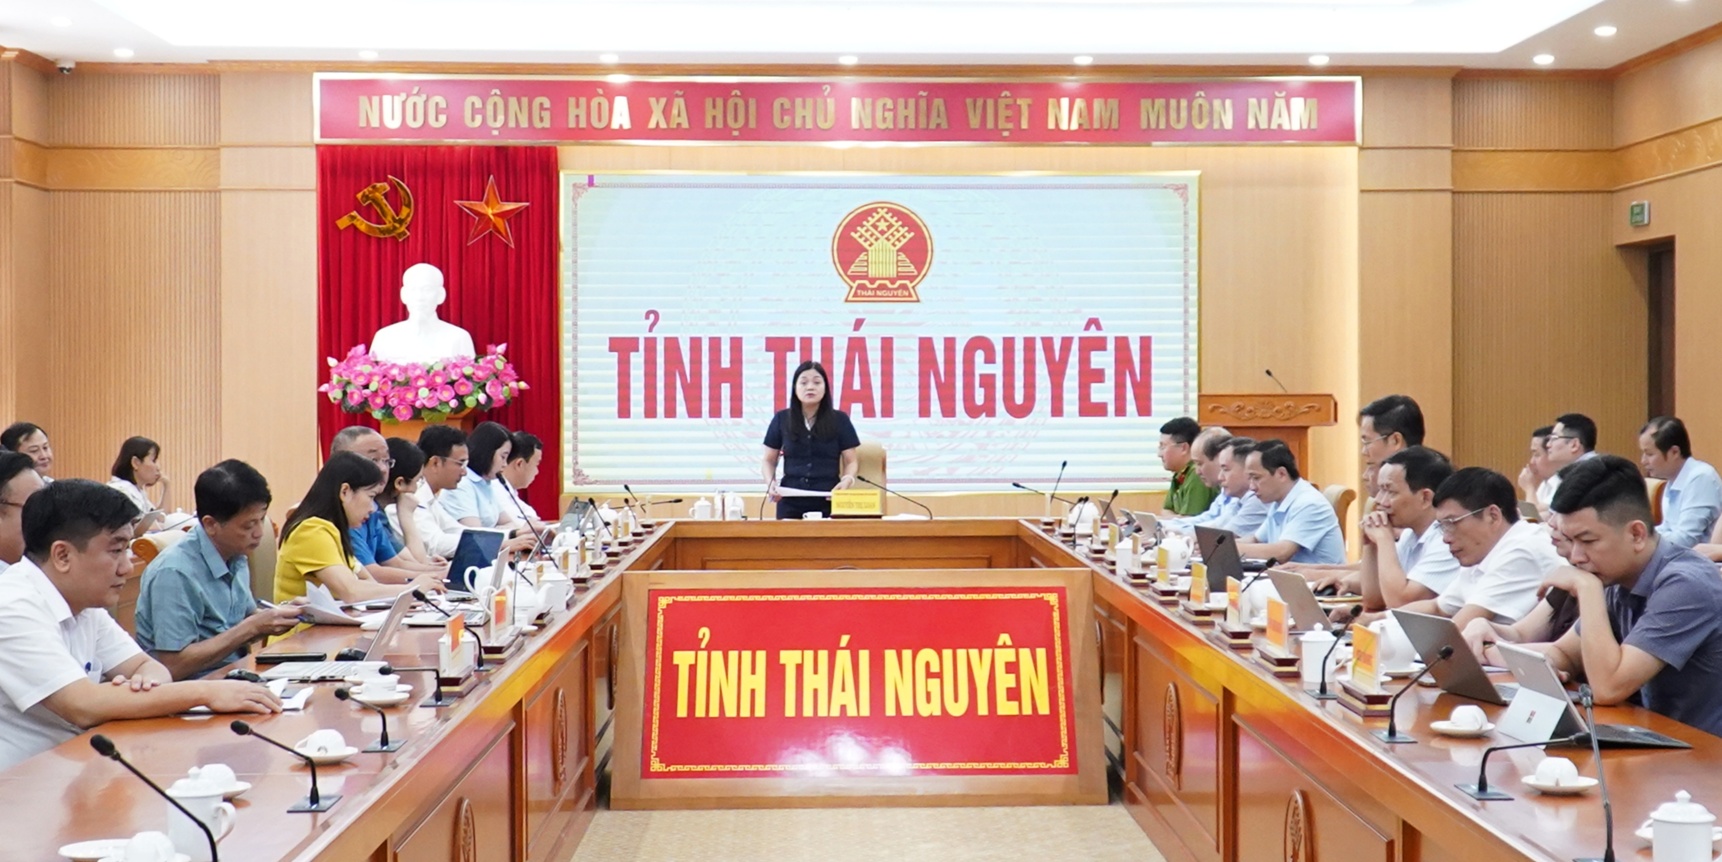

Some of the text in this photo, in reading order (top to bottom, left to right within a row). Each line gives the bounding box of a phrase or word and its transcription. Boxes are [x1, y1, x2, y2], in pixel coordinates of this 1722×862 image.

[359, 85, 1319, 137] NƯỚC CỘNG HÒA XÃ HỘI CHỦ NGHĨA VIỆT NAM MUÔN NĂM
[608, 309, 743, 419] TỈNH
[919, 317, 1153, 419] NGUYÊN
[672, 626, 1050, 718] TỈNH THÁI NGUYÊN
